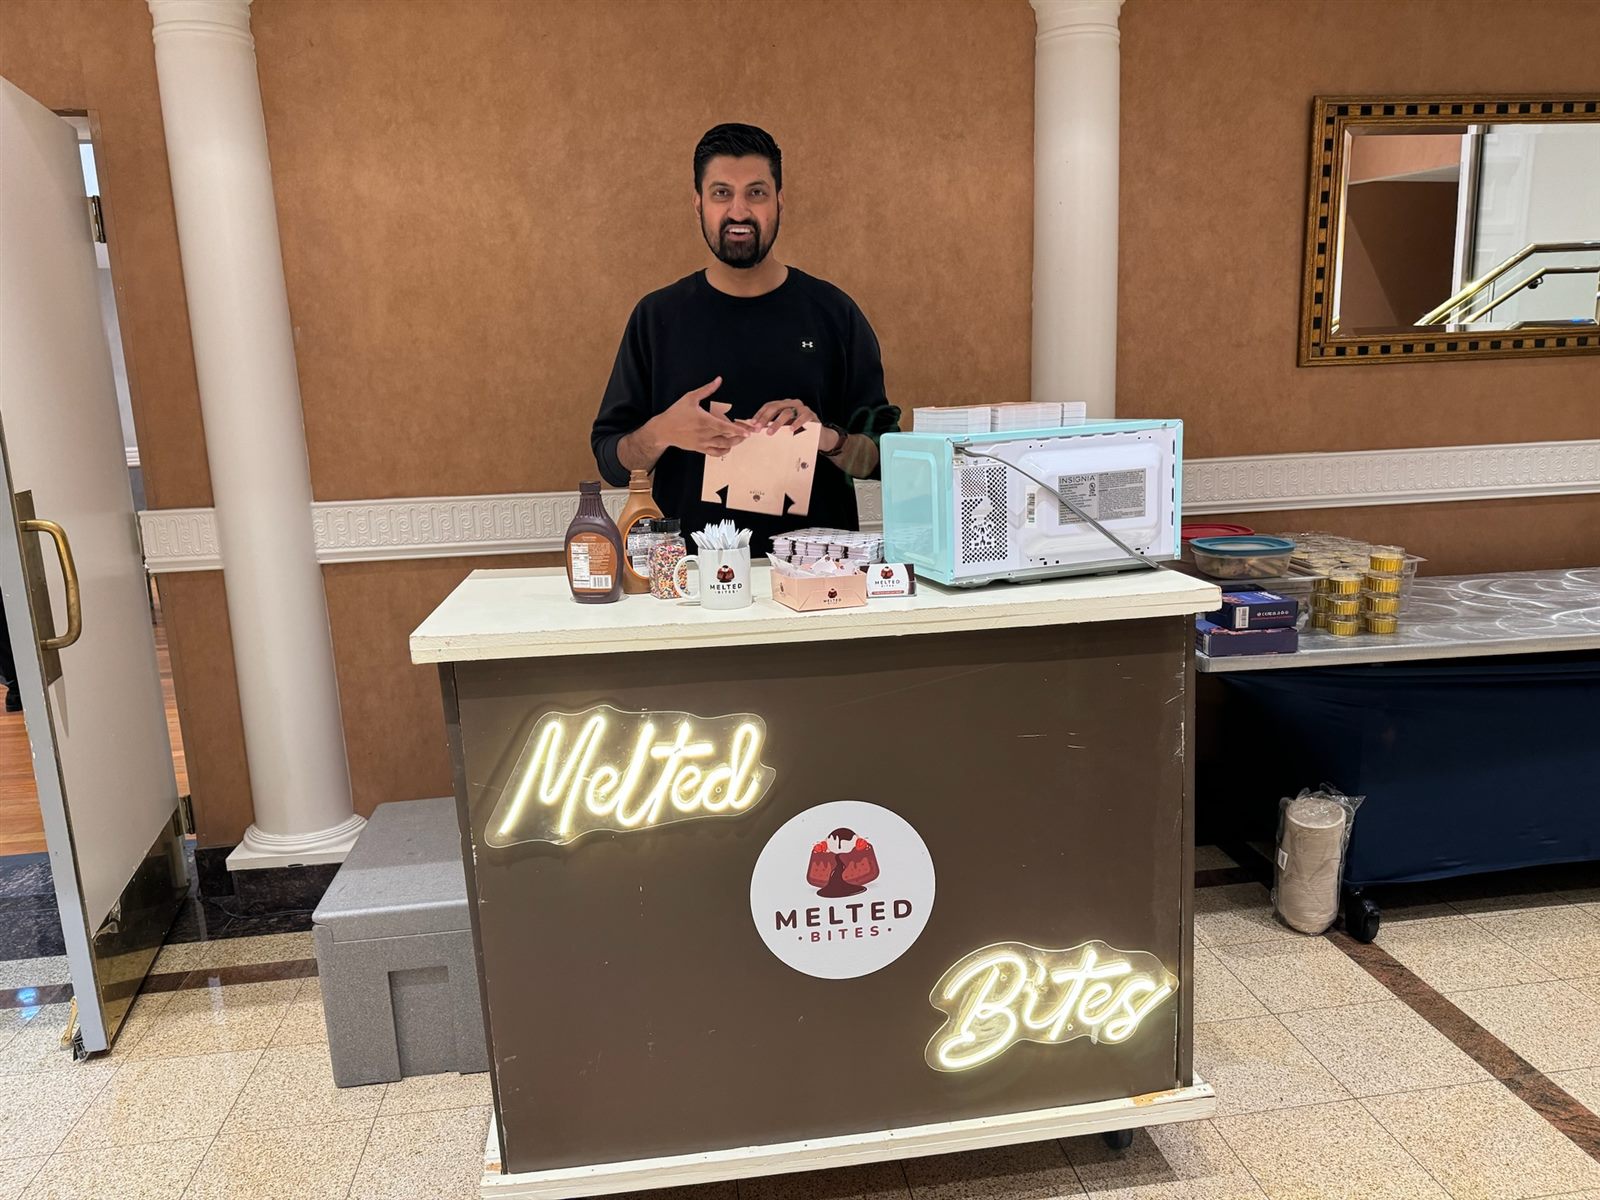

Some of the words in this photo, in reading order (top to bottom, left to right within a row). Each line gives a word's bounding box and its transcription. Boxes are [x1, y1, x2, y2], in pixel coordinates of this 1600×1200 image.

[1060, 475, 1096, 484] INSIGNIA
[497, 715, 761, 837] Melted
[775, 900, 913, 931] MELTED
[810, 926, 880, 943] BITES
[938, 947, 1174, 1069] Bites
